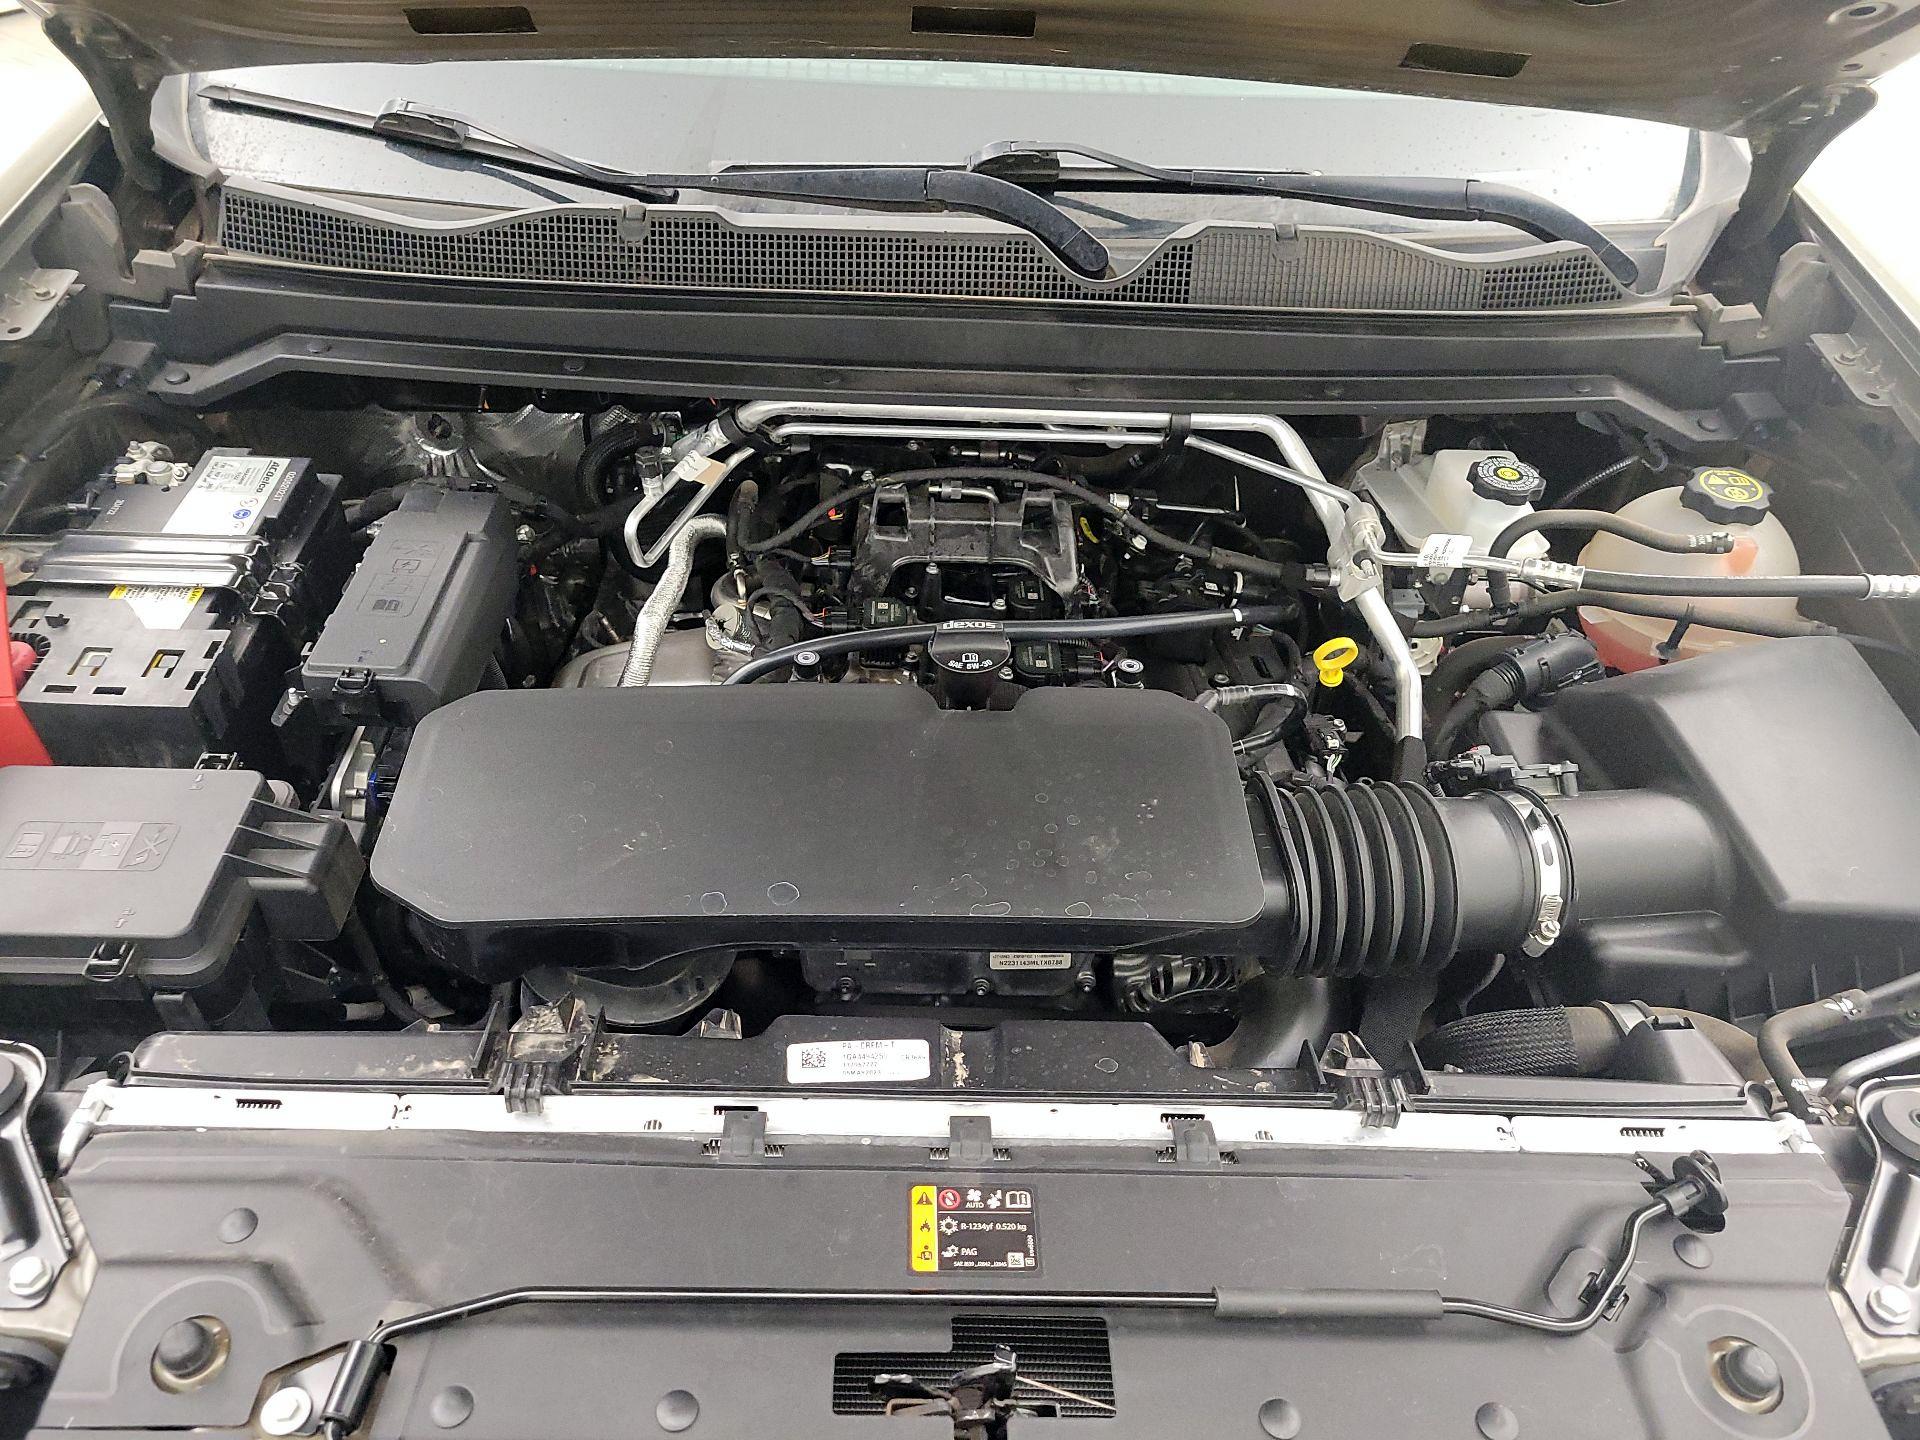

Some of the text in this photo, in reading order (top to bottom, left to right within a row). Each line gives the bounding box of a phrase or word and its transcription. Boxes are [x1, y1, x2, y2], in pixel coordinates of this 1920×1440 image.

[256, 461, 280, 493] ACDelco
[942, 620, 996, 630] dexos
[947, 659, 993, 670] SAE 5W-30
[960, 1222, 1027, 1232] R-1234yf 0.520 kg
[960, 1247, 978, 1256] PAG
